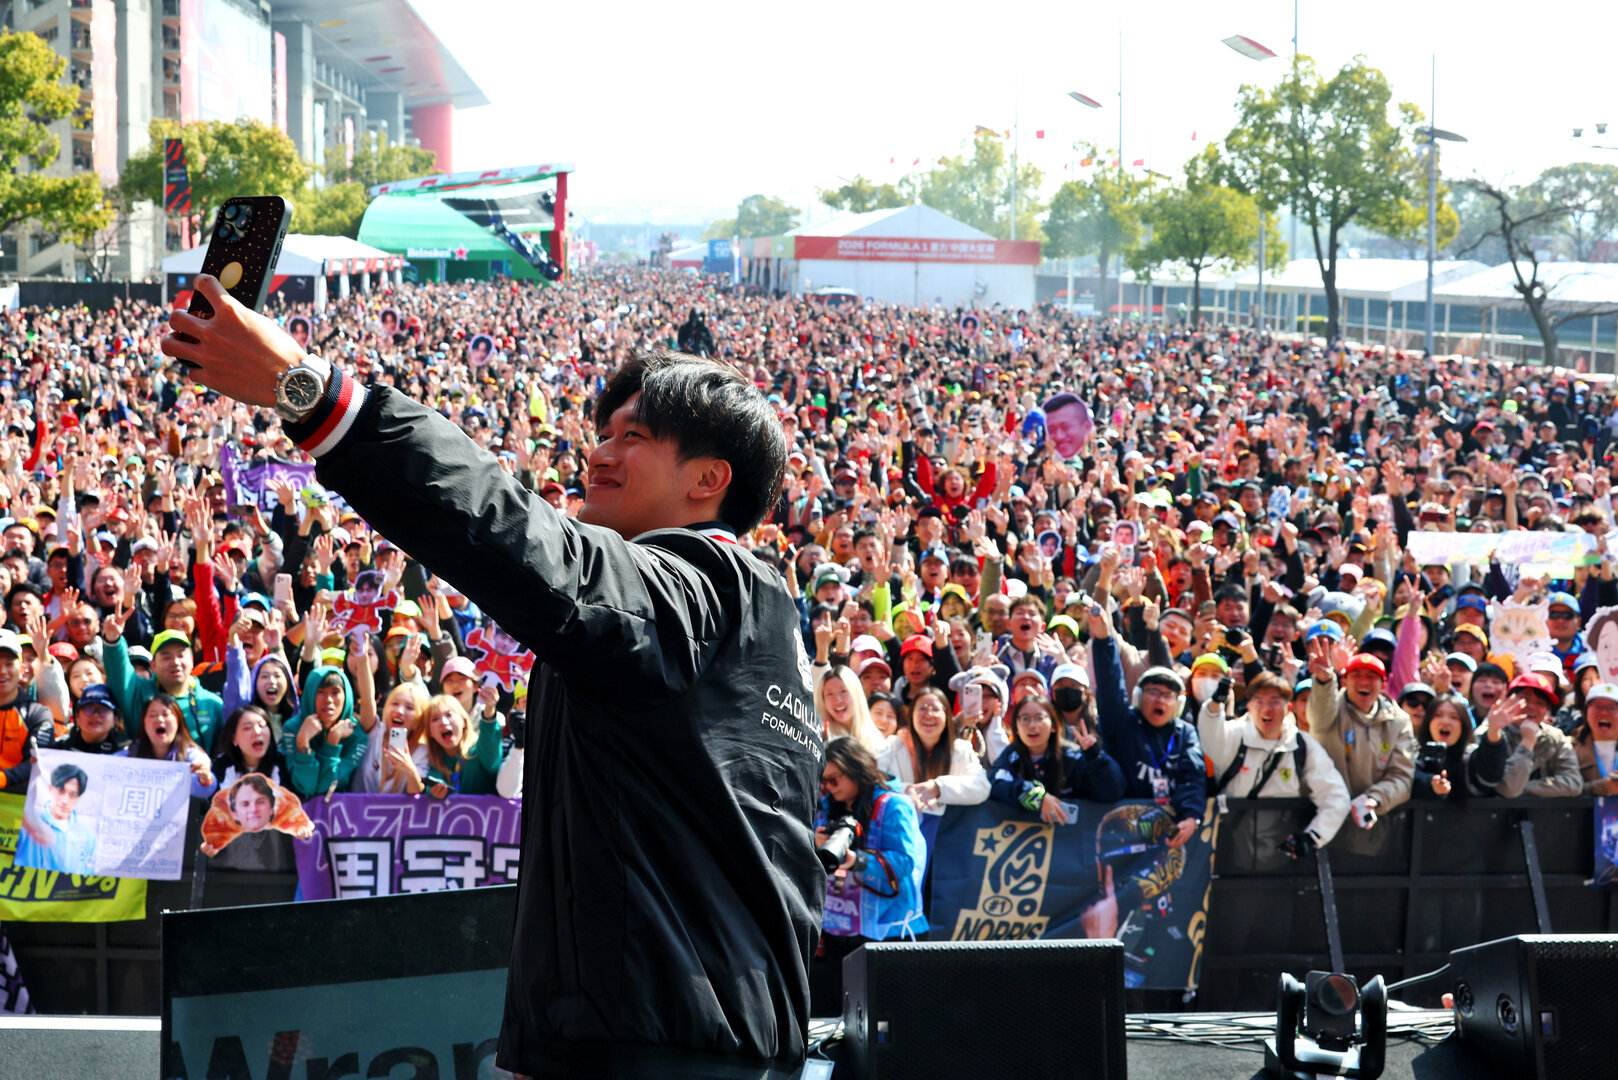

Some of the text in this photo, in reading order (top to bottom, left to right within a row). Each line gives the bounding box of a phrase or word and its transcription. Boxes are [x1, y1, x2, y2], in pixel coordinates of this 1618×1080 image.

[866, 241, 920, 252] FORMULA
[766, 684, 823, 742] CADILLA
[761, 711, 808, 749] FORMULA
[824, 894, 859, 917] EDIA
[955, 917, 1043, 941] NORRIS
